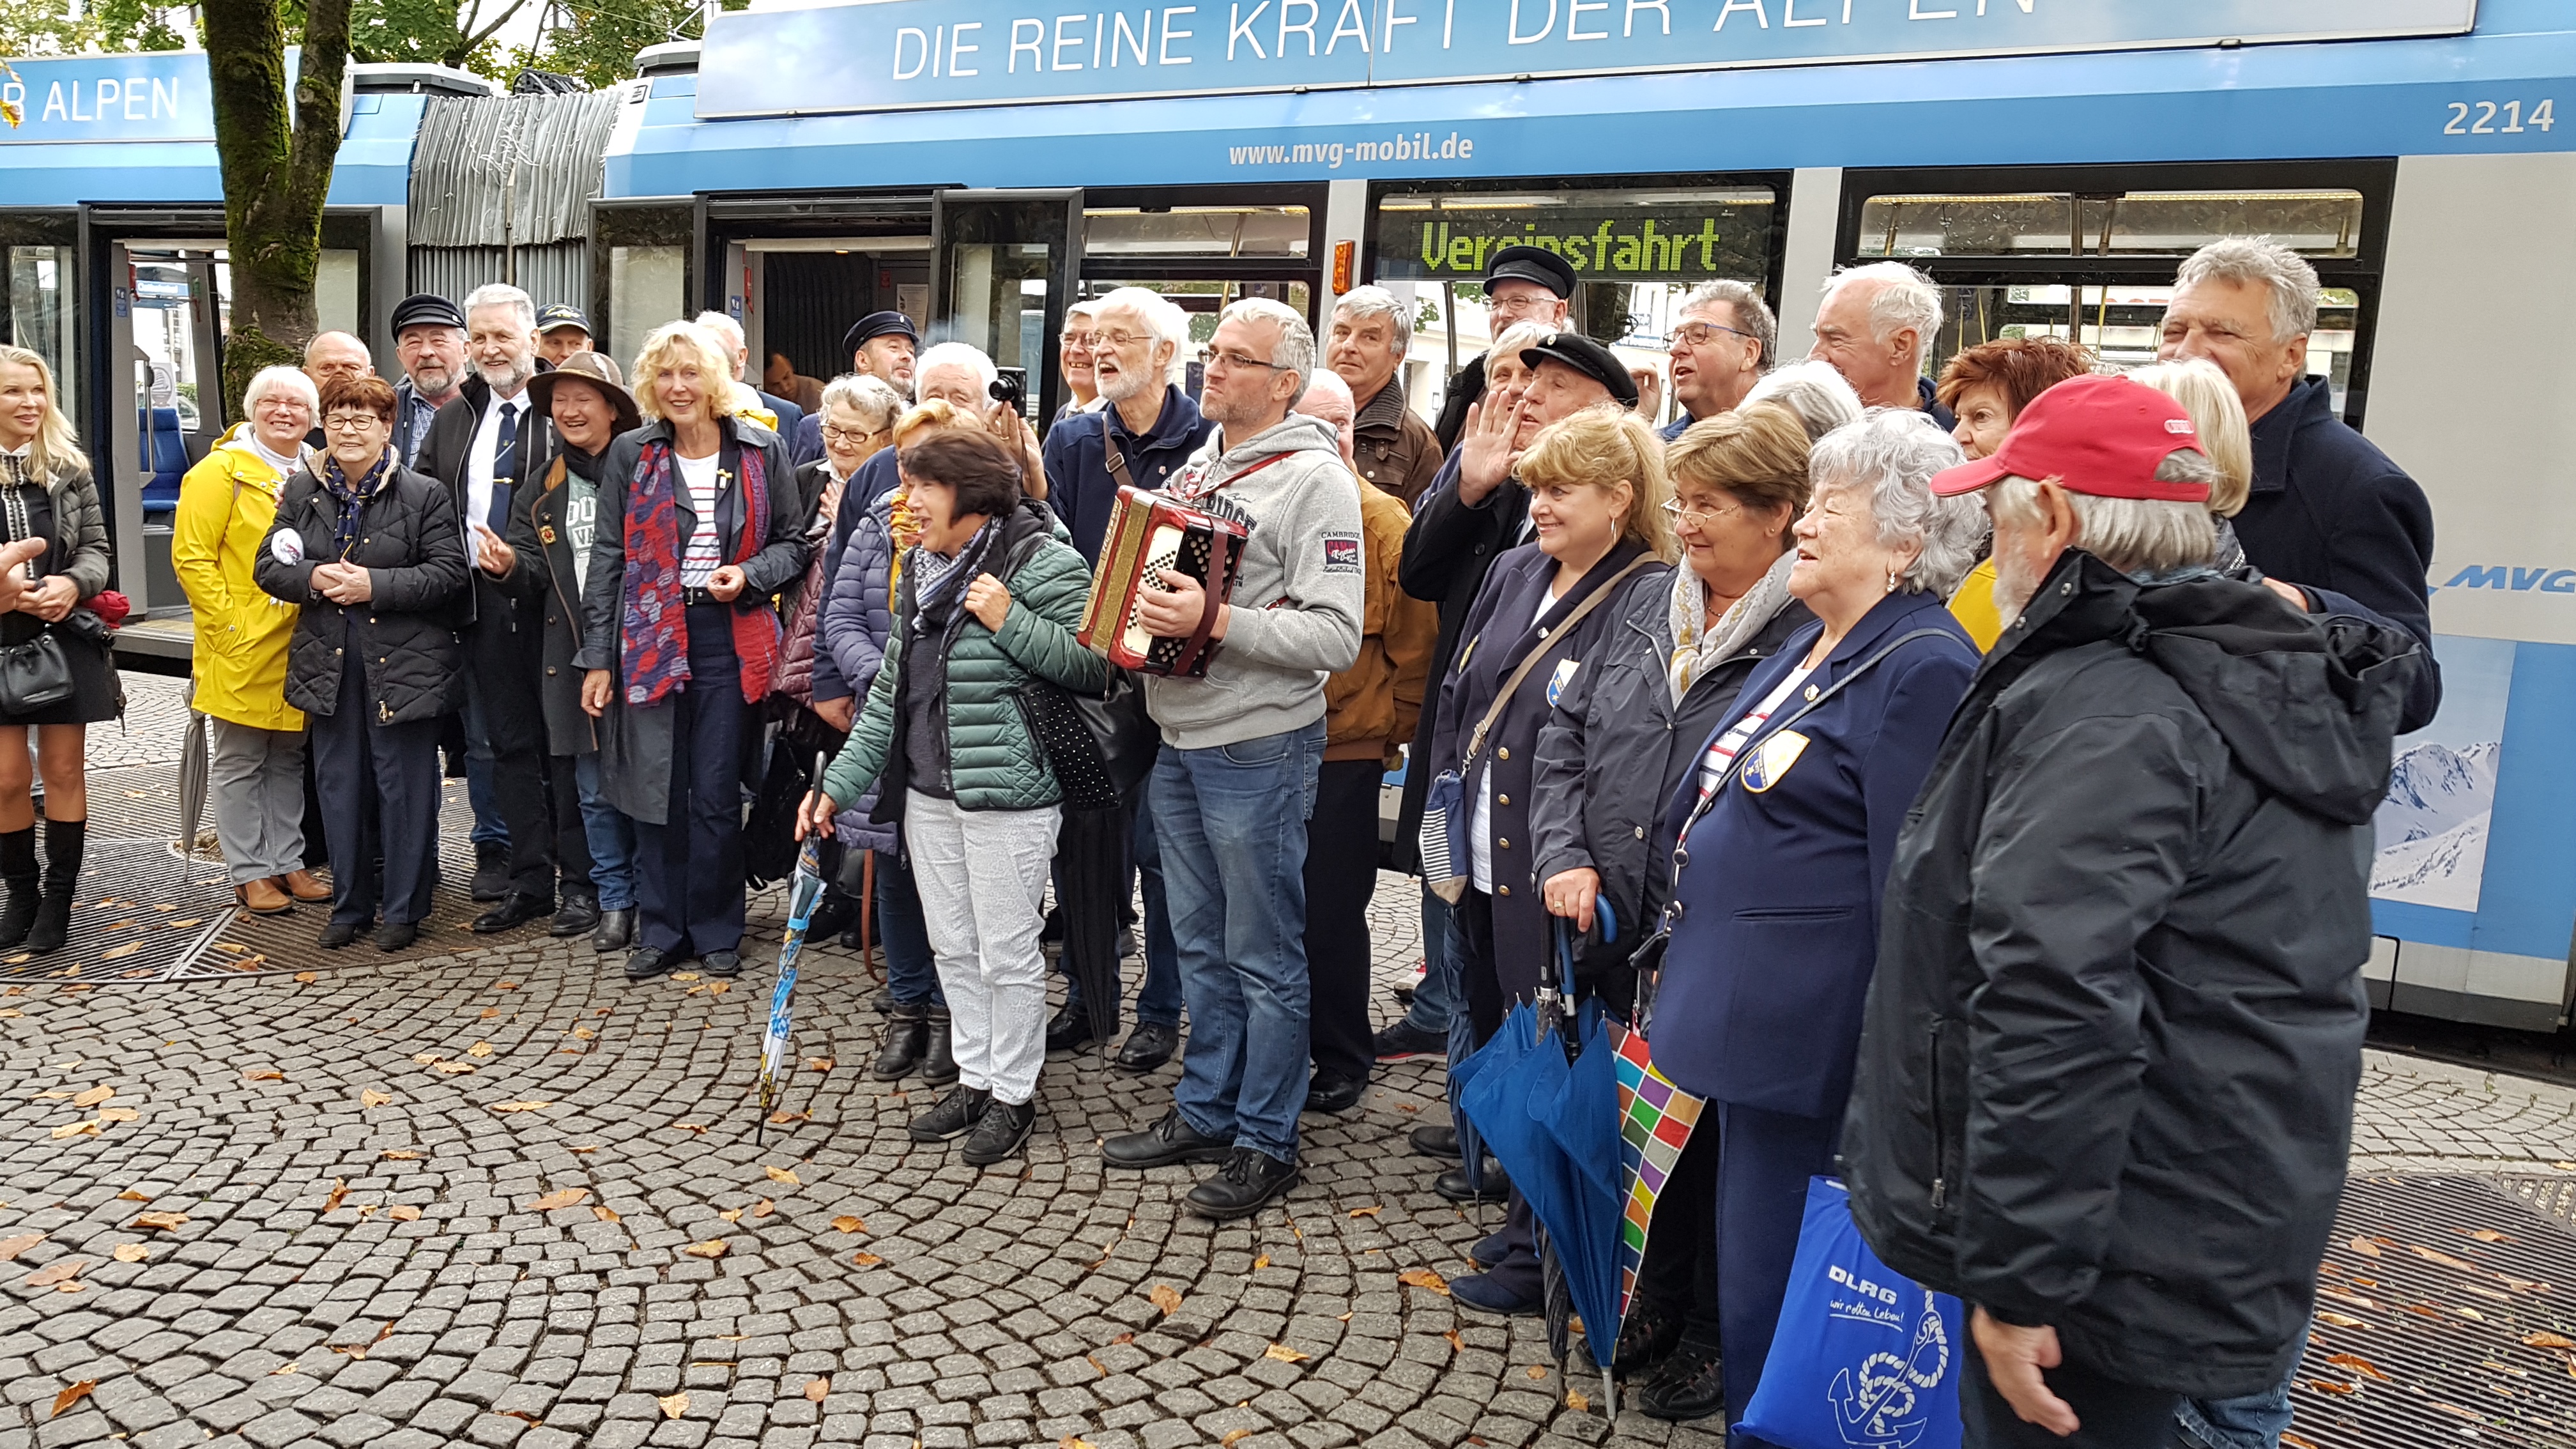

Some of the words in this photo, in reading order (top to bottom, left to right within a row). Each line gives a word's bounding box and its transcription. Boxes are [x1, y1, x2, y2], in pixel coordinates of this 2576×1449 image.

[893, 22, 982, 80] DIE
[1008, 6, 1197, 73] REINE
[1507, 0, 1671, 45] DER
[42, 76, 178, 121] ALPEN
[2443, 98, 2555, 135] 2214
[1229, 131, 1474, 169] www.mvg-mobil.de
[2444, 565, 2576, 594] MVG
[1828, 1265, 1897, 1305] DLRG
[1830, 1299, 1844, 1310] wir
